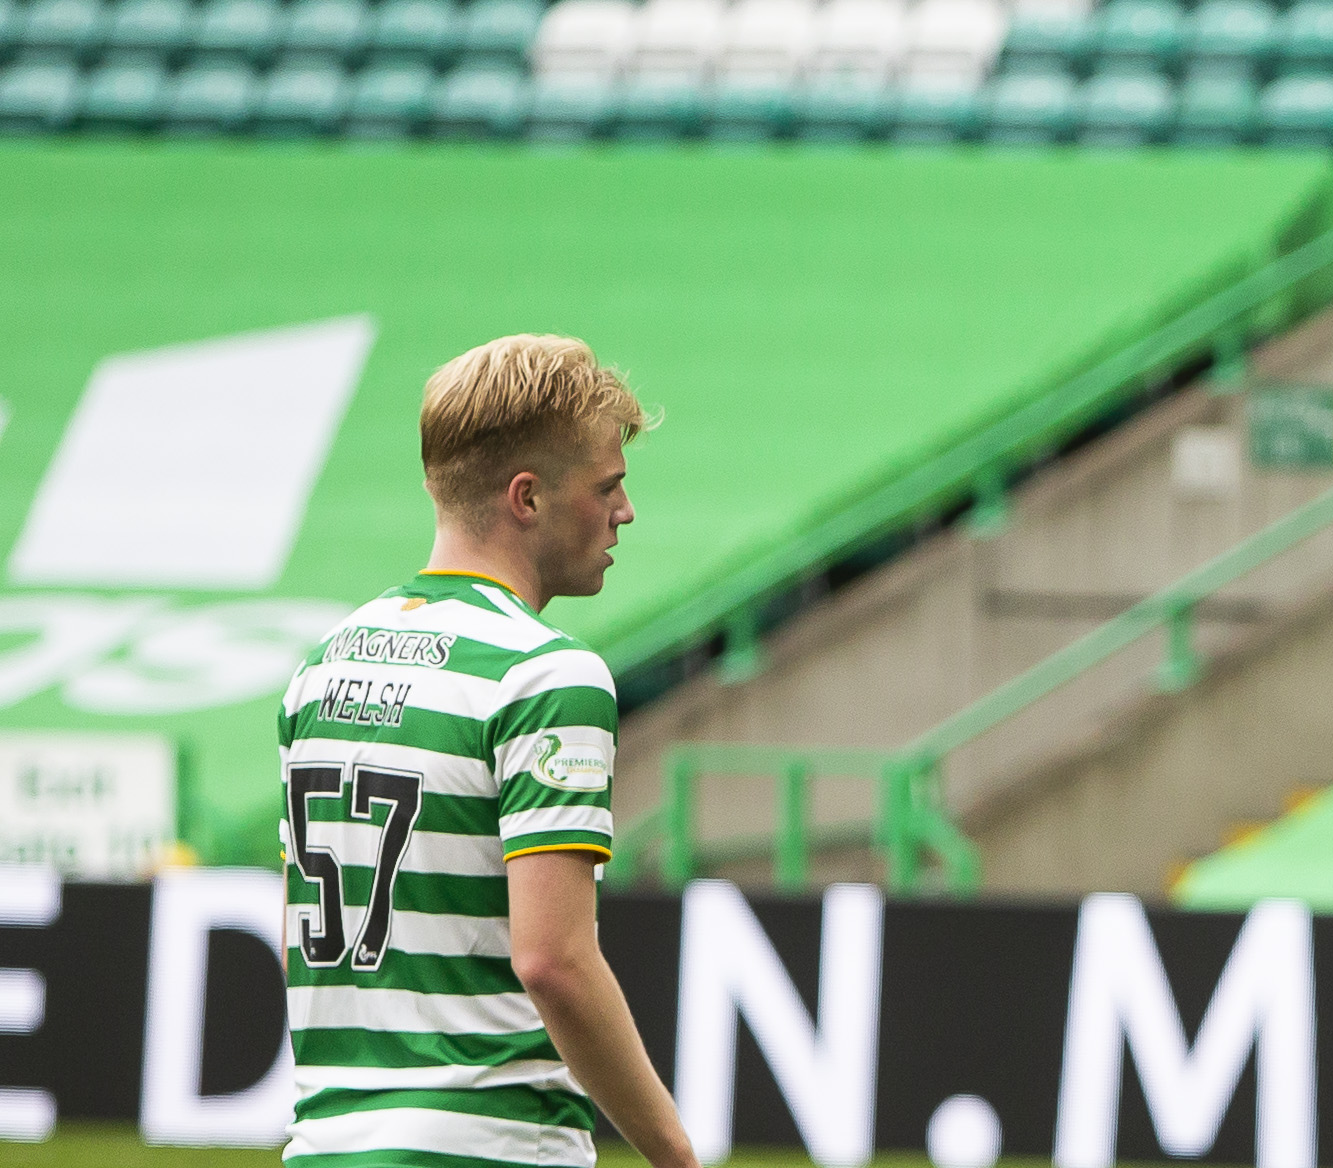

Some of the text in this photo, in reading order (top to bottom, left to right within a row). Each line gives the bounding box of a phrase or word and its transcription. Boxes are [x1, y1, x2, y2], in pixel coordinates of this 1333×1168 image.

[324, 627, 457, 669] MAGNERS
[317, 677, 412, 727] WELSH
[286, 761, 425, 972] 57
